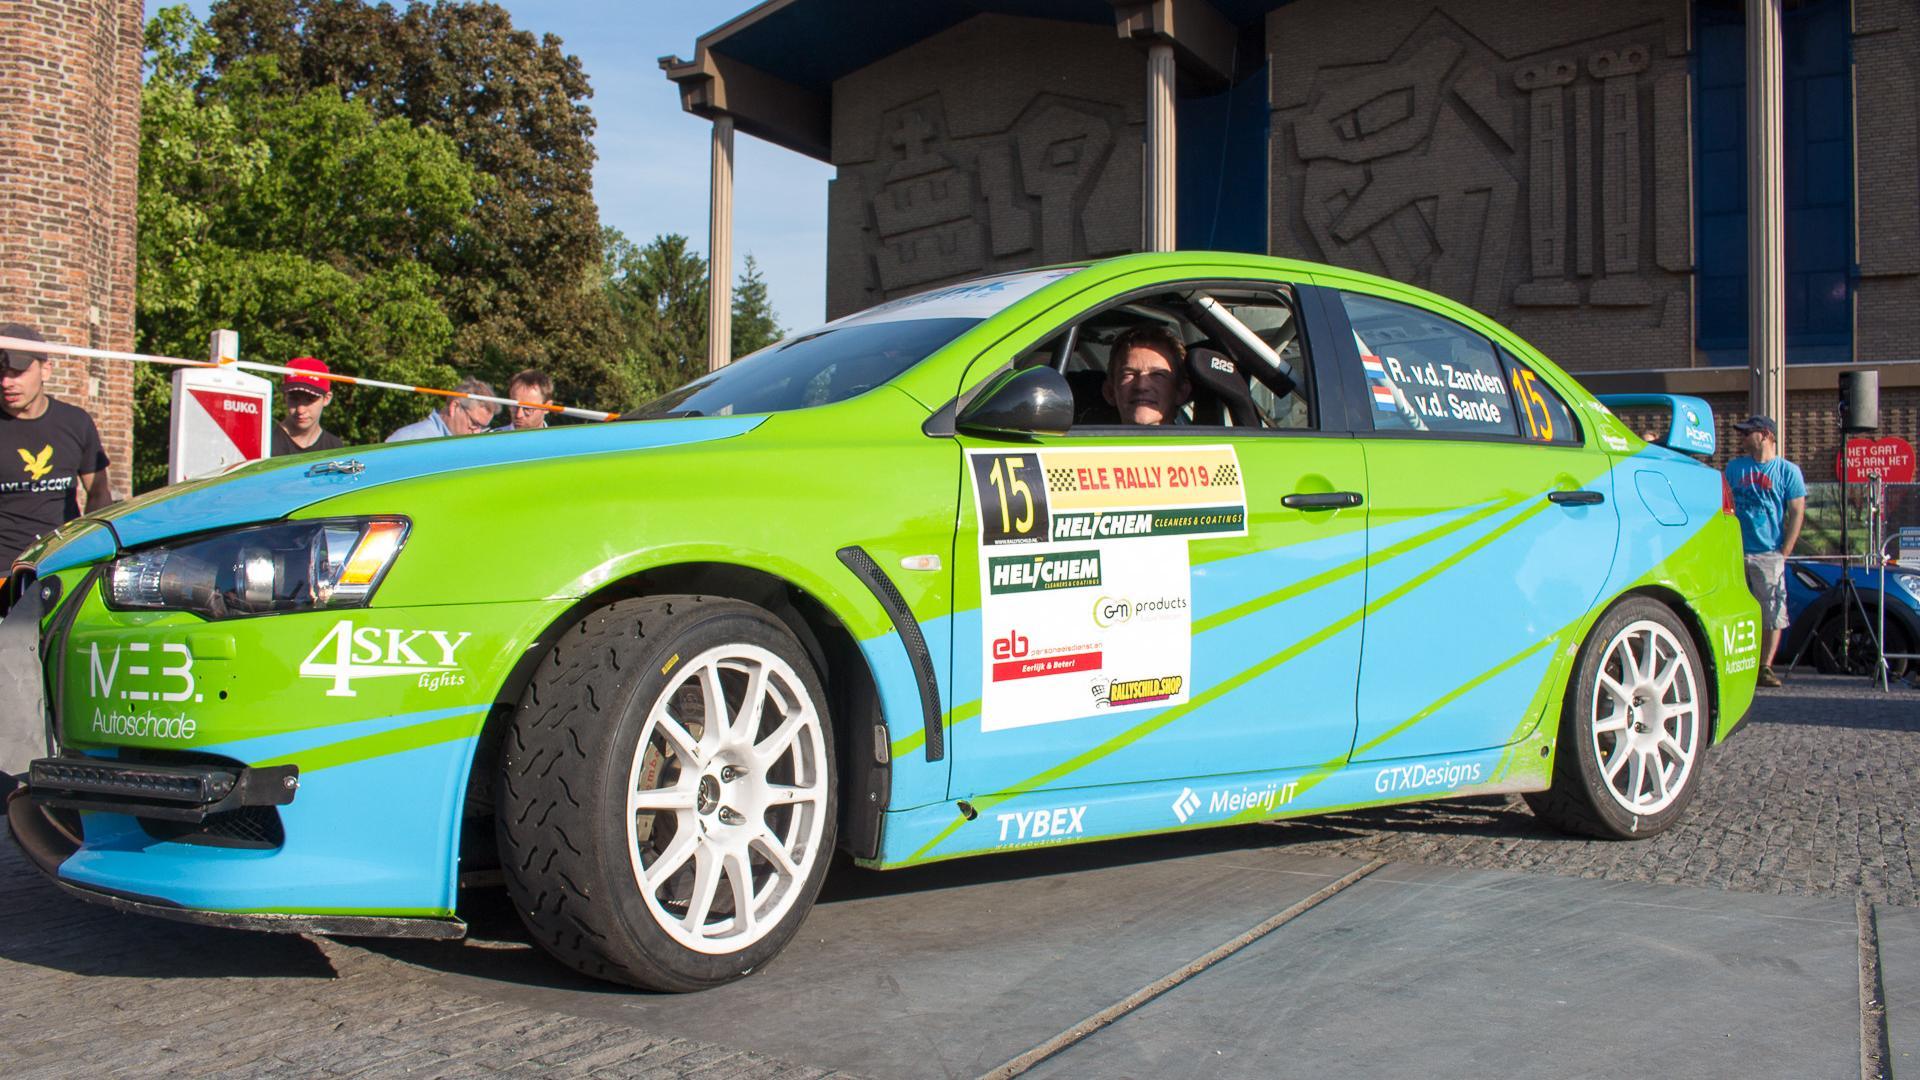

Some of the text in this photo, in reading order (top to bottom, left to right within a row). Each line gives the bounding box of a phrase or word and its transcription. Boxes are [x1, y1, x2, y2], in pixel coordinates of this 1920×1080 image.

[1211, 356, 1234, 373] RRS
[1386, 356, 1505, 395] R. v.d. Zanden
[223, 399, 258, 415] BUKO.
[1414, 392, 1448, 418] v.d.
[1447, 393, 1501, 423] Sande
[1512, 367, 1553, 441] 15
[1841, 455, 1909, 468] NS AAN HET
[1848, 444, 1898, 457] HET GAAT
[1077, 465, 1209, 490] ELE RALLY 2019
[990, 457, 1035, 534] 15
[1154, 516, 1192, 528] CLEANERS
[1200, 513, 1242, 525] COATINGS
[1135, 596, 1187, 616] products
[993, 629, 1029, 660] eb
[1021, 659, 1076, 673] Eerlijk & Beter!
[417, 669, 466, 692] lights
[1110, 675, 1182, 702] RALLYSCHILD.SHOP
[91, 706, 196, 740] Autoschade
[1374, 760, 1482, 793] GTXDesigns
[1208, 781, 1299, 814] Meierij IT
[997, 805, 1088, 841] TYBEX
